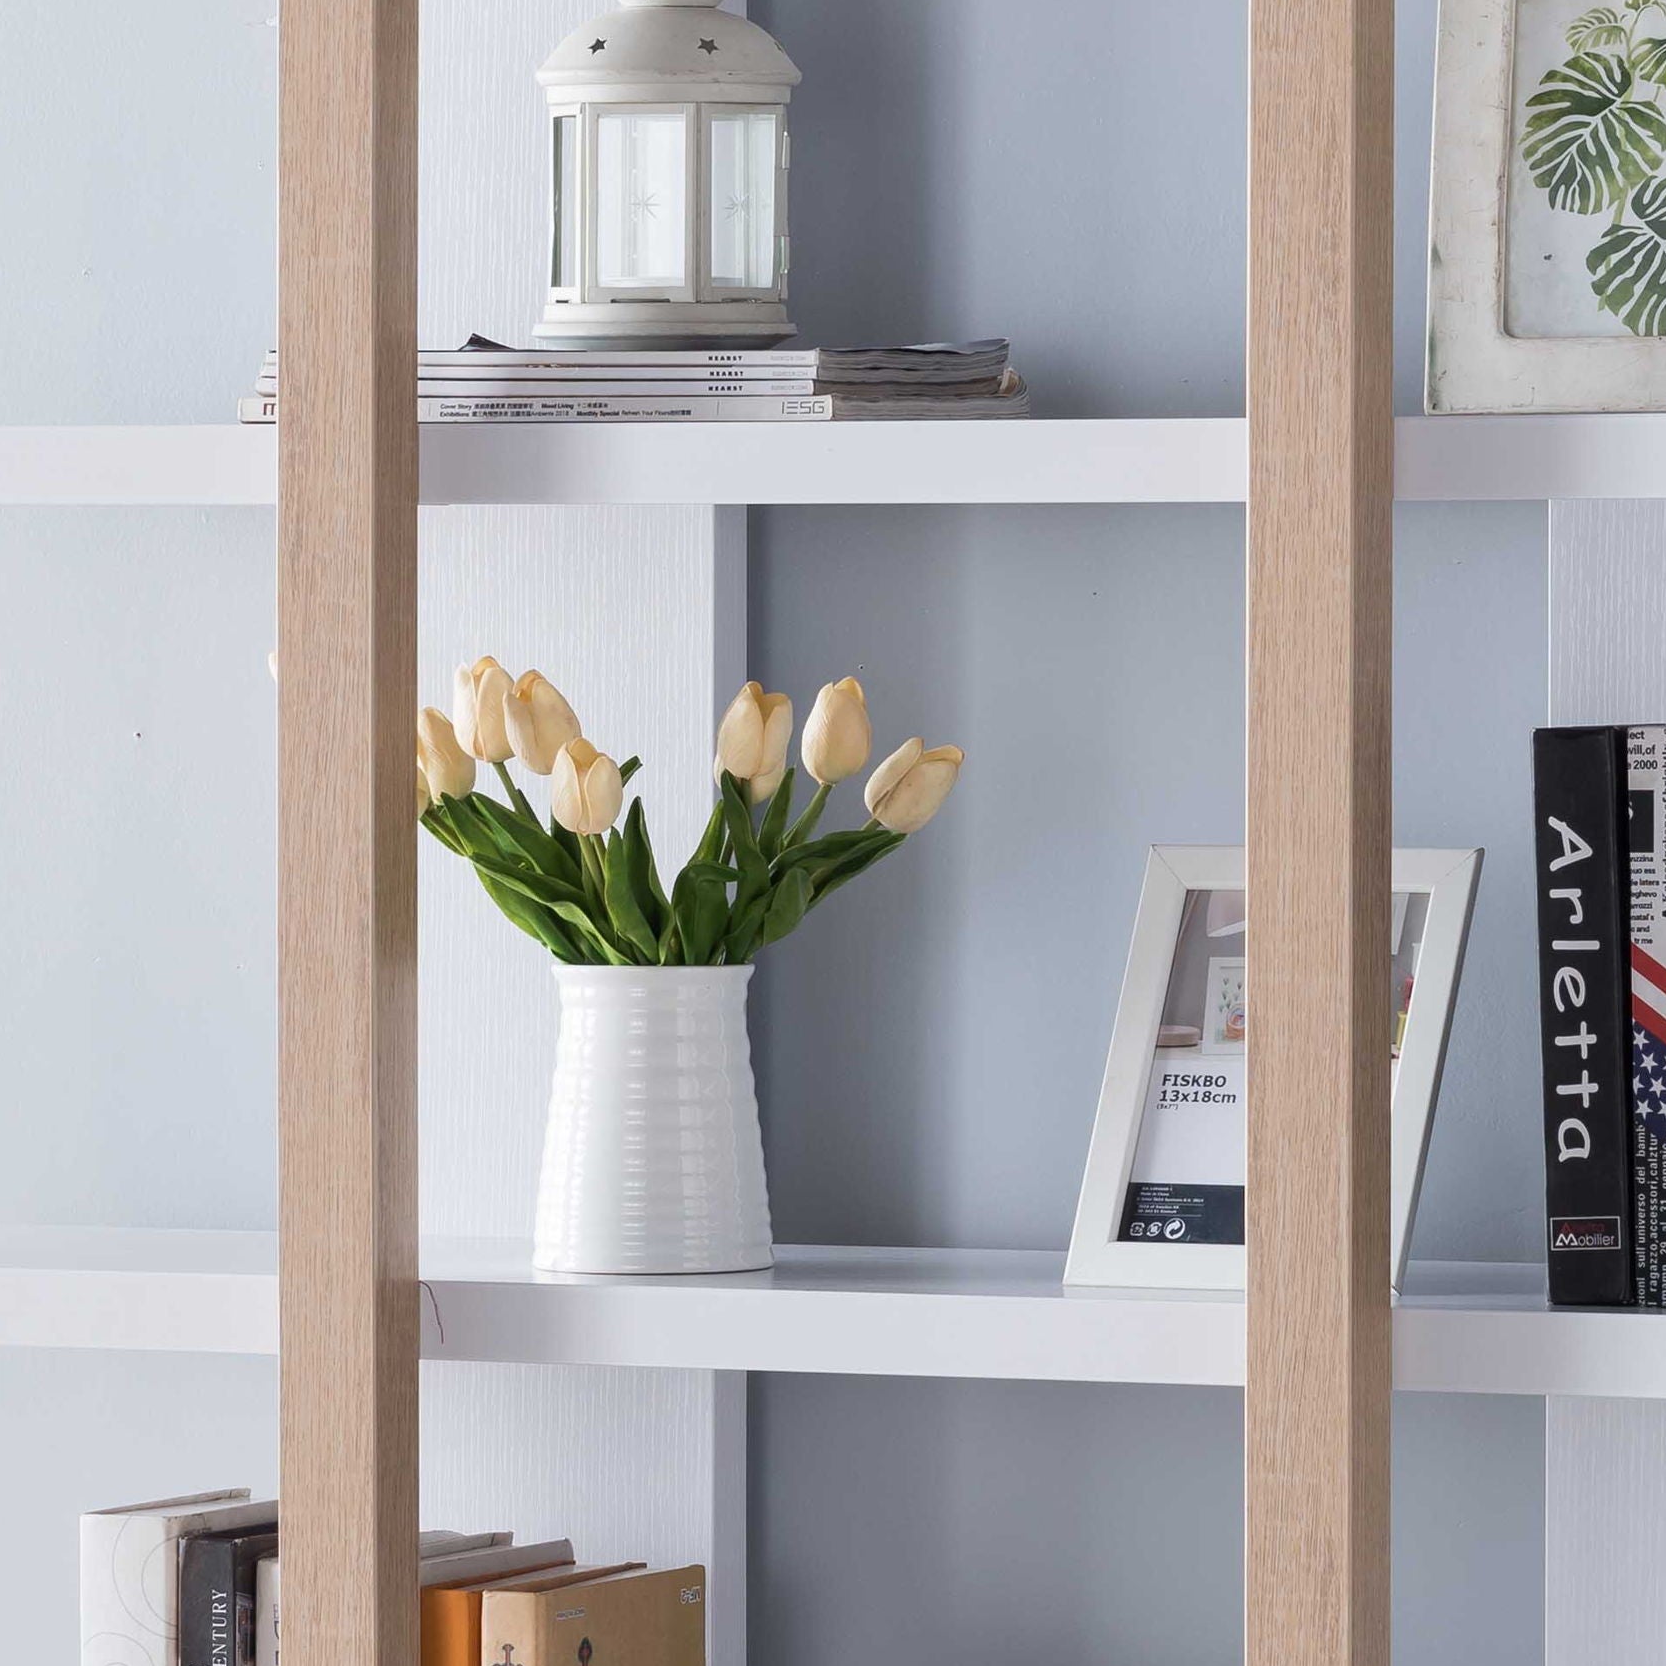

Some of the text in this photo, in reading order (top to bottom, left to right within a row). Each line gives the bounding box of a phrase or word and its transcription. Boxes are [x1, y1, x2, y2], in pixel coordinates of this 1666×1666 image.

[1633, 760, 1658, 770] 2000
[1549, 815, 1600, 1163] Arletta
[1162, 1074, 1227, 1088] FISKBO
[1159, 1090, 1237, 1104] 13x18cm
[1635, 1166, 1645, 1184] del
